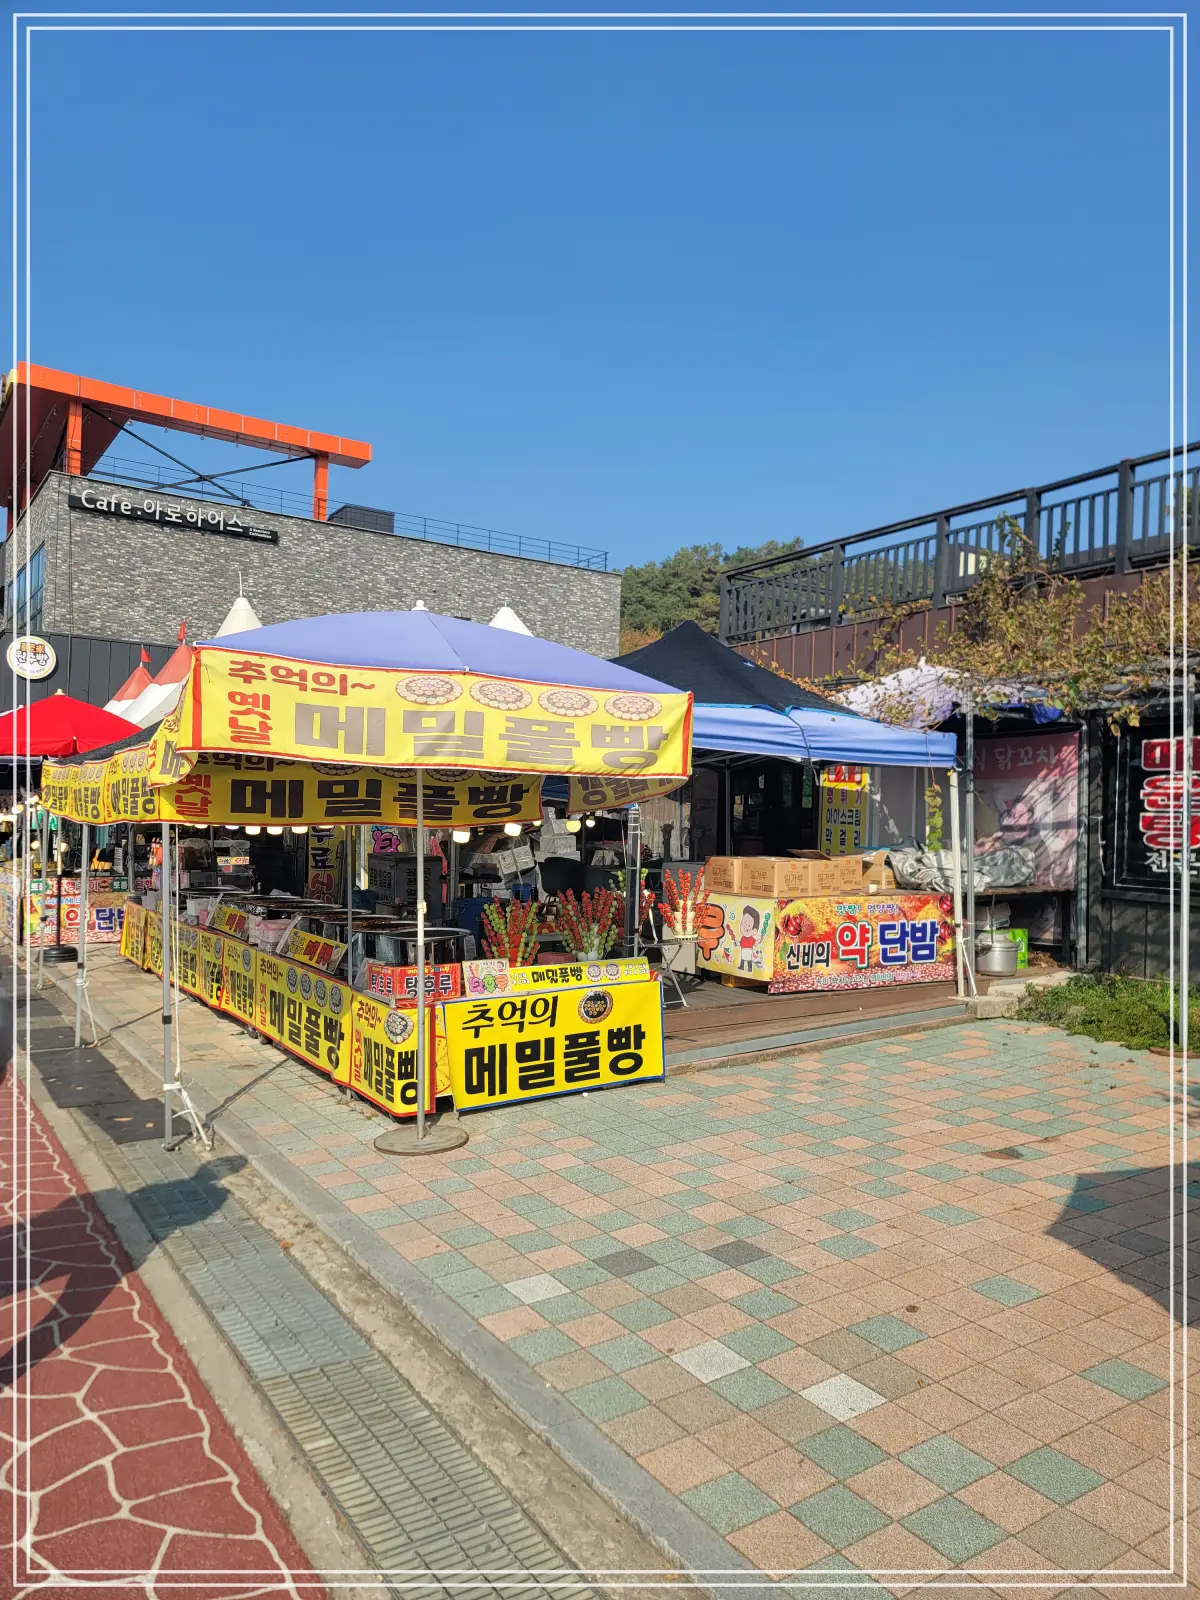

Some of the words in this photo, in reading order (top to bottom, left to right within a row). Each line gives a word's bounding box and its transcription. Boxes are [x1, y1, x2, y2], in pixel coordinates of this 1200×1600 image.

[295, 703, 669, 770] 메밀풀빵
[230, 779, 530, 820] 메밀풀빵
[826, 808, 861, 826] 아이스크림
[787, 942, 831, 970] 신비의
[837, 922, 872, 966] 약
[879, 920, 940, 963] 단밤
[531, 966, 583, 984] 메밀풀빵
[269, 989, 345, 1070] 메밀풀빵
[461, 995, 559, 1039] 추억의
[464, 1023, 646, 1097] 메밀풀빵
